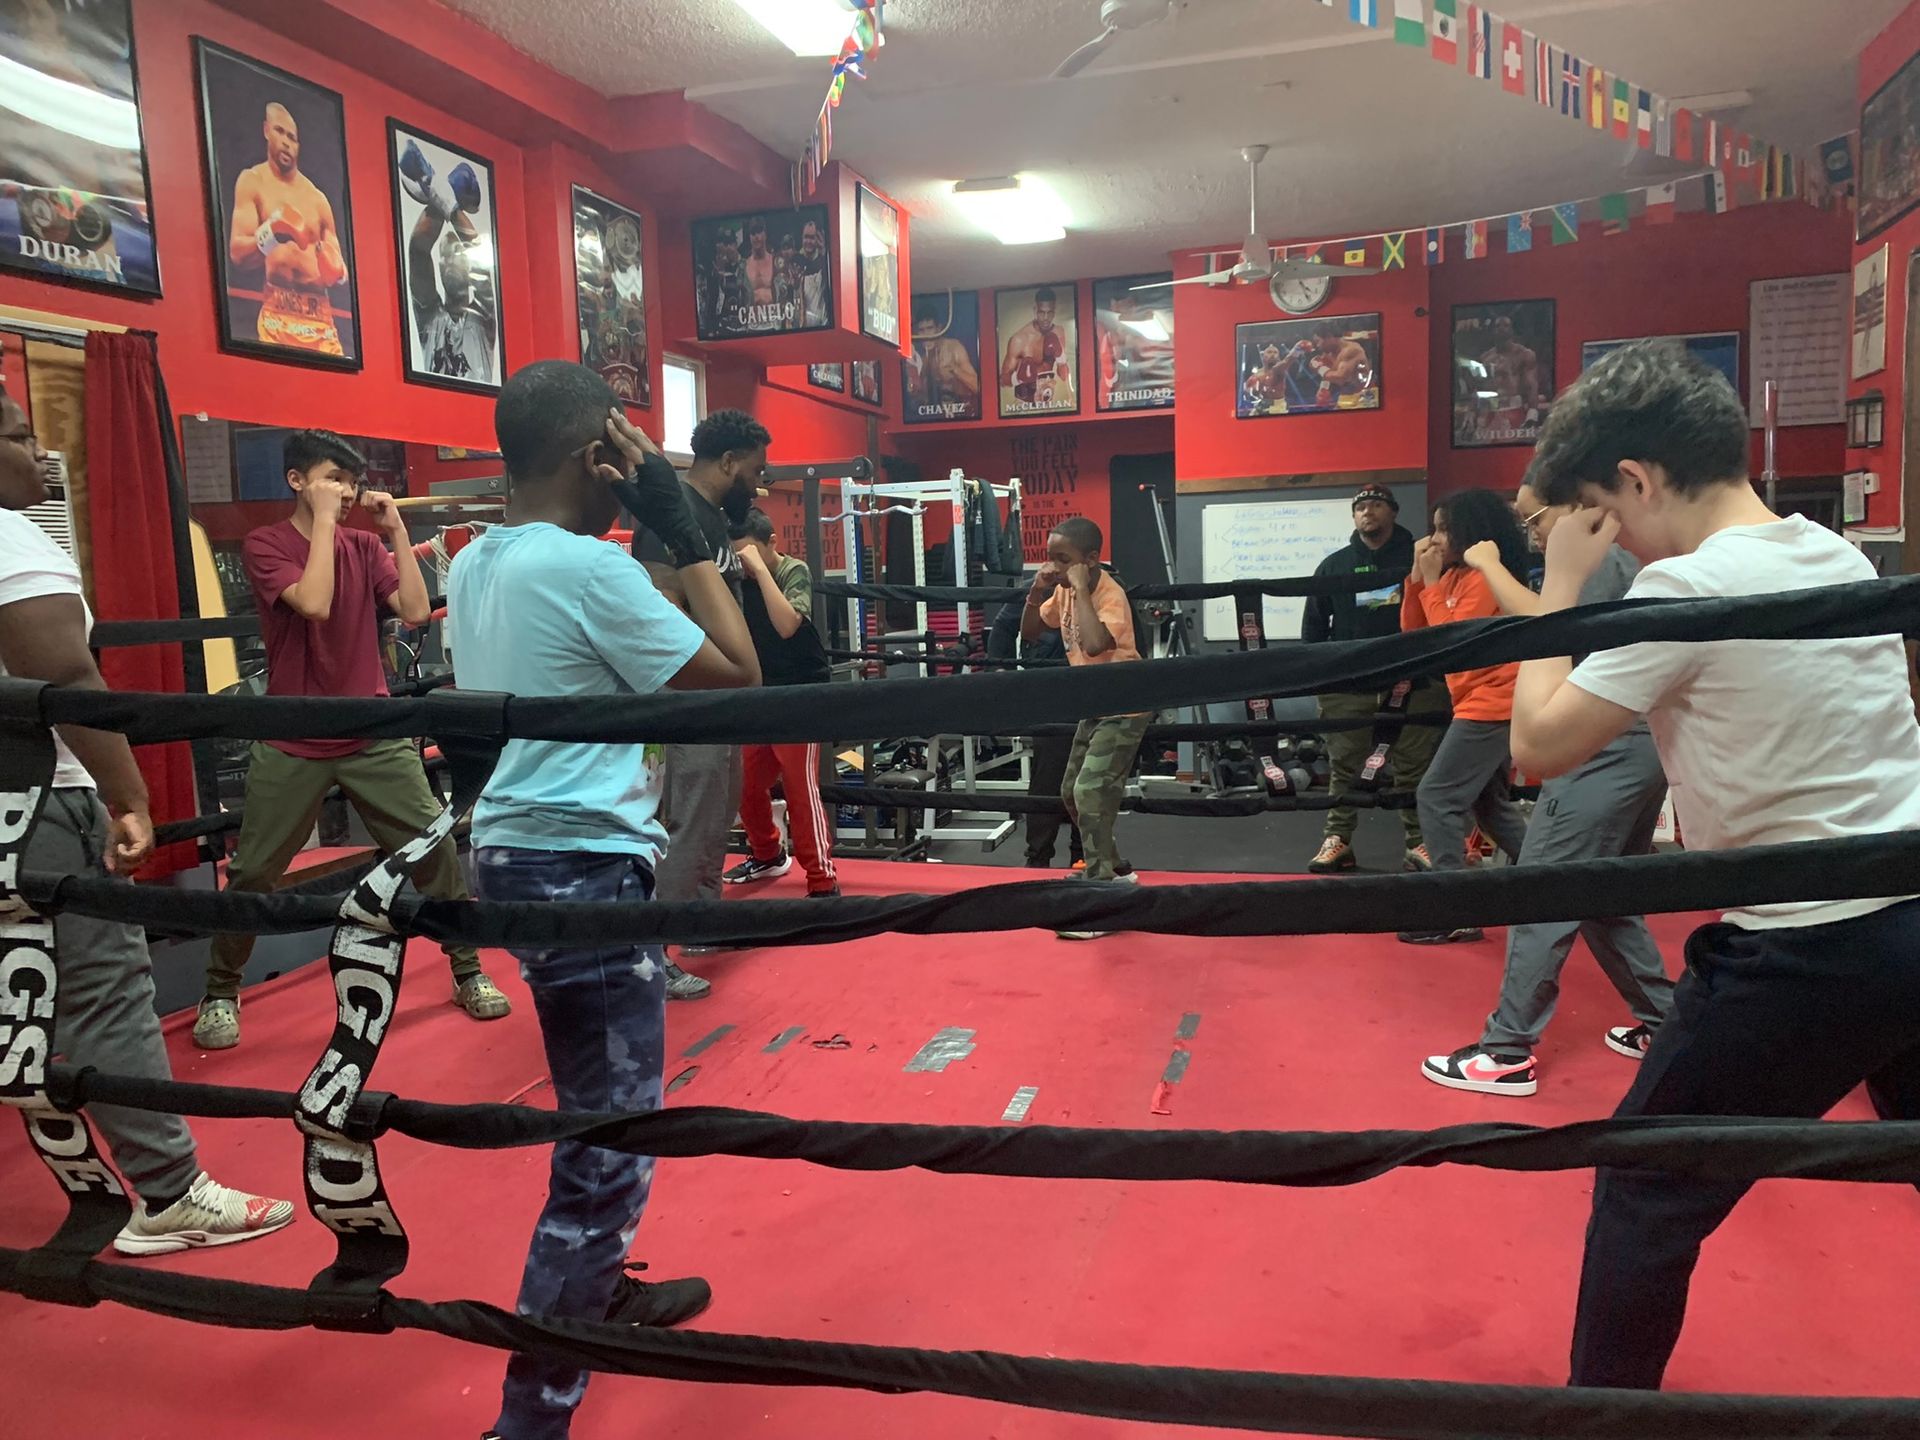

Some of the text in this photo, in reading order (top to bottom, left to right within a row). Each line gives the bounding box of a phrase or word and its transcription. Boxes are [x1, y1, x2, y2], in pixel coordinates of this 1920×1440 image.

[18, 234, 127, 285] DURAN
[1106, 387, 1173, 403] TRINIDAD
[918, 402, 966, 416] CHAVEZ
[1009, 431, 1079, 455] THE PAIN
[1476, 428, 1536, 440] WILDER
[1011, 452, 1078, 472] YOU FEEL
